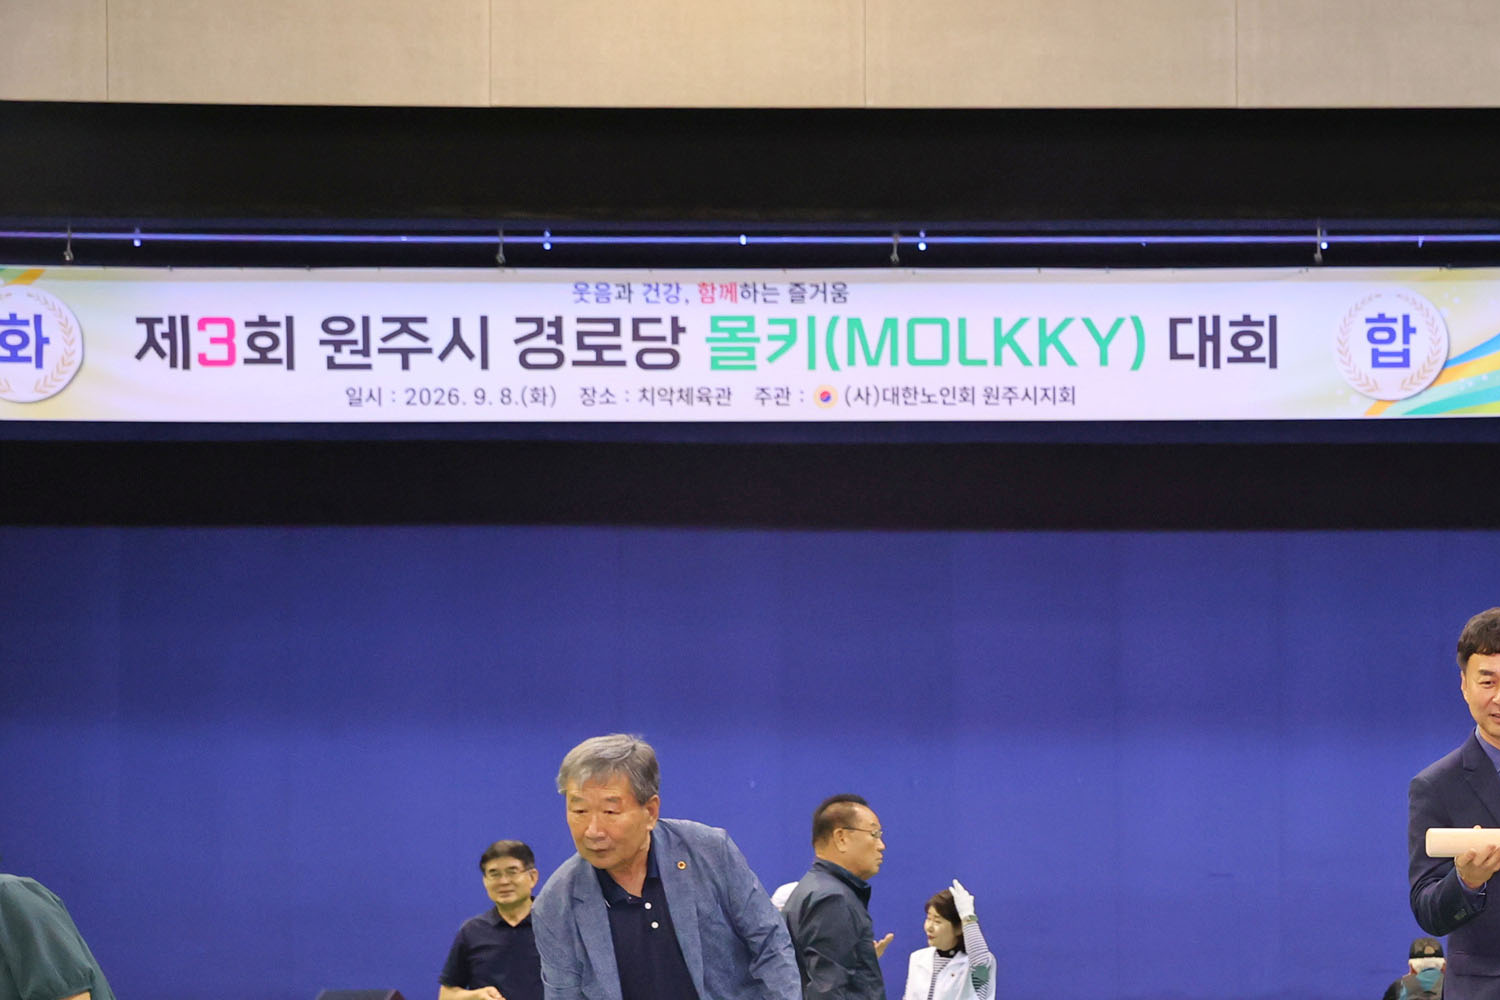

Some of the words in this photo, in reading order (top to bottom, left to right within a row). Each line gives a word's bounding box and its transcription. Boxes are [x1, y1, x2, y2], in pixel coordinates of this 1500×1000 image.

[572, 282, 634, 304] 웃음과
[643, 282, 690, 305] 건강,
[698, 282, 781, 304] 함께하는
[788, 281, 849, 304] 즐거움
[0, 313, 50, 369] 화
[135, 315, 296, 371] 제3회
[319, 315, 490, 371] 원주시
[513, 315, 687, 371] 경로당
[705, 314, 1146, 371] 몰키(MOLKKY)
[1169, 314, 1278, 370] 대회
[1365, 313, 1416, 369] 합
[346, 387, 382, 407] 일시
[405, 388, 467, 406] 2026.
[474, 388, 493, 406] 9.
[581, 387, 617, 406] 장소
[639, 387, 733, 407] 치악체육관
[755, 387, 791, 406] 주관
[845, 385, 976, 407] (사)대한노인회
[983, 386, 1076, 407] 원주시지회
